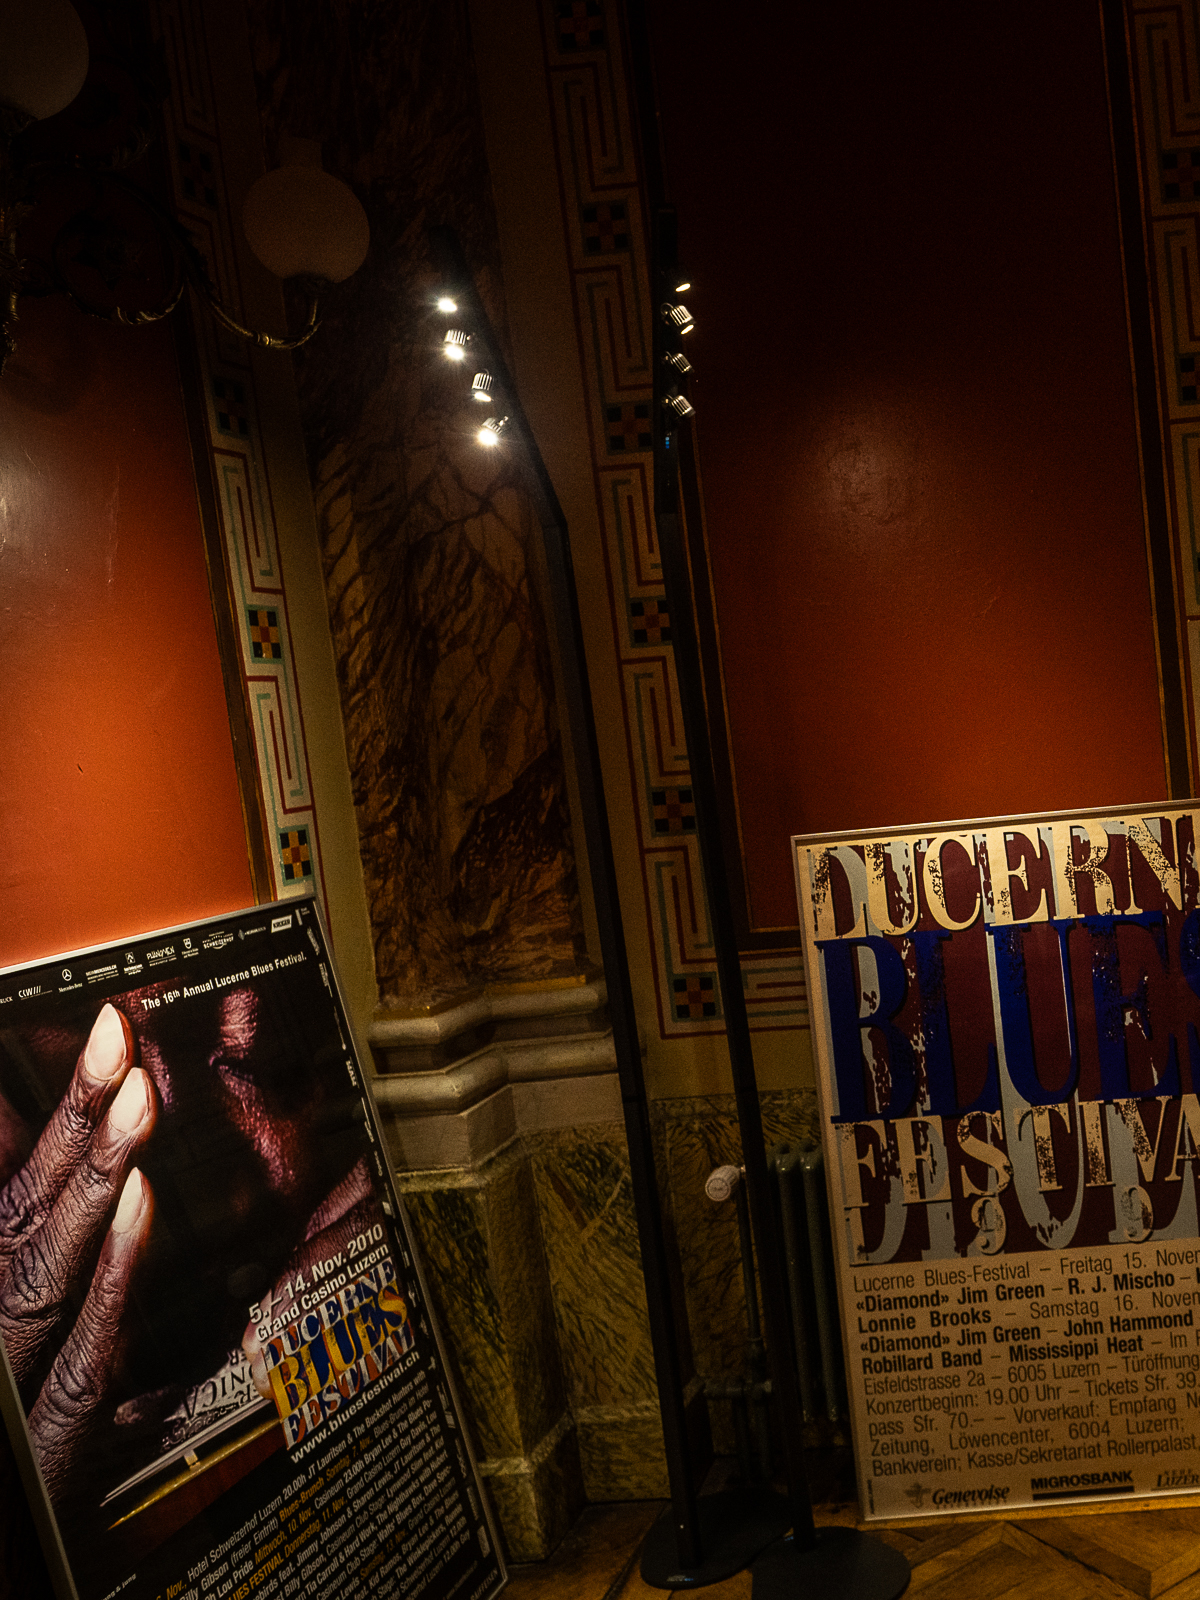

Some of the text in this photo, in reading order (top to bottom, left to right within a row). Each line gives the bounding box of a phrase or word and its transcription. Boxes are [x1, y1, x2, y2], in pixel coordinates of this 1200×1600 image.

[141, 951, 307, 1011] The 16th Annual Lucerne Blues Festival.
[247, 1224, 384, 1325] 5. 14. Nov. 2010
[255, 1242, 388, 1343] Grand Casino Luzern
[853, 1274, 914, 1297] Lucerne
[923, 1261, 1030, 1290] Blues-Festival
[1059, 1255, 1113, 1275] Freitag
[1122, 1250, 1146, 1269] 15.
[956, 1286, 988, 1304] Jim
[995, 1283, 1045, 1301] Green
[1067, 1277, 1085, 1295] R.
[1091, 1275, 1106, 1293] J.
[1112, 1270, 1174, 1290] Mischo
[260, 1254, 396, 1374] LUCERNE
[857, 1314, 916, 1338] Lonnie
[929, 1306, 991, 1329] Brooks
[1029, 1299, 1099, 1319] Samstag
[1114, 1293, 1138, 1311] 16.
[956, 1328, 987, 1346] Jim
[992, 1325, 1041, 1343] Green
[1063, 1318, 1104, 1337] John
[1109, 1309, 1193, 1332] Hammond
[266, 1275, 409, 1423] BLUES
[861, 1352, 933, 1374] Robillard
[940, 1348, 982, 1368] Band
[1008, 1338, 1098, 1361] Mississippi
[1106, 1334, 1143, 1353] Heat
[1169, 1332, 1187, 1347] Im
[279, 1319, 415, 1451] FESTIVAL
[863, 1374, 960, 1400] Eisfeldstrasse
[966, 1369, 986, 1387] 2a
[1007, 1363, 1047, 1384] 6005
[1051, 1358, 1100, 1379] Luzern
[865, 1392, 978, 1416] Konzertbeginn:
[984, 1385, 1029, 1405] 19.00
[1034, 1383, 1061, 1402] Uhr
[1084, 1378, 1139, 1396] Tickets
[1143, 1373, 1169, 1392] Sfr.
[289, 1347, 420, 1468] www.bluesfestival.ch
[867, 1420, 904, 1441] pass
[912, 1414, 938, 1433] Sfr.
[1013, 1400, 1099, 1423] Vorverkauf:
[1108, 1395, 1176, 1416] Empfang
[870, 1438, 934, 1461] Zeitung,
[948, 1427, 1053, 1450] Löwencenter,
[1067, 1419, 1110, 1440] 6004
[1125, 1411, 1184, 1435] Luzern;
[872, 1453, 962, 1481] Bankverein;
[967, 1442, 1101, 1468] Kasse/Sekretariat
[1106, 1434, 1200, 1456] Rollerpalast,
[186, 1555, 209, 1582] Hotel
[209, 1513, 257, 1563] Schweizerhof
[257, 1494, 282, 1521] Luzern
[281, 1473, 307, 1500] 20.00h
[307, 1460, 319, 1479] JT
[315, 1439, 347, 1470] Lauritsen
[351, 1422, 365, 1438] The
[364, 1398, 392, 1428] Buckshot
[932, 1484, 1009, 1506] Genevoise
[1031, 1471, 1133, 1490] MIGROSBANK
